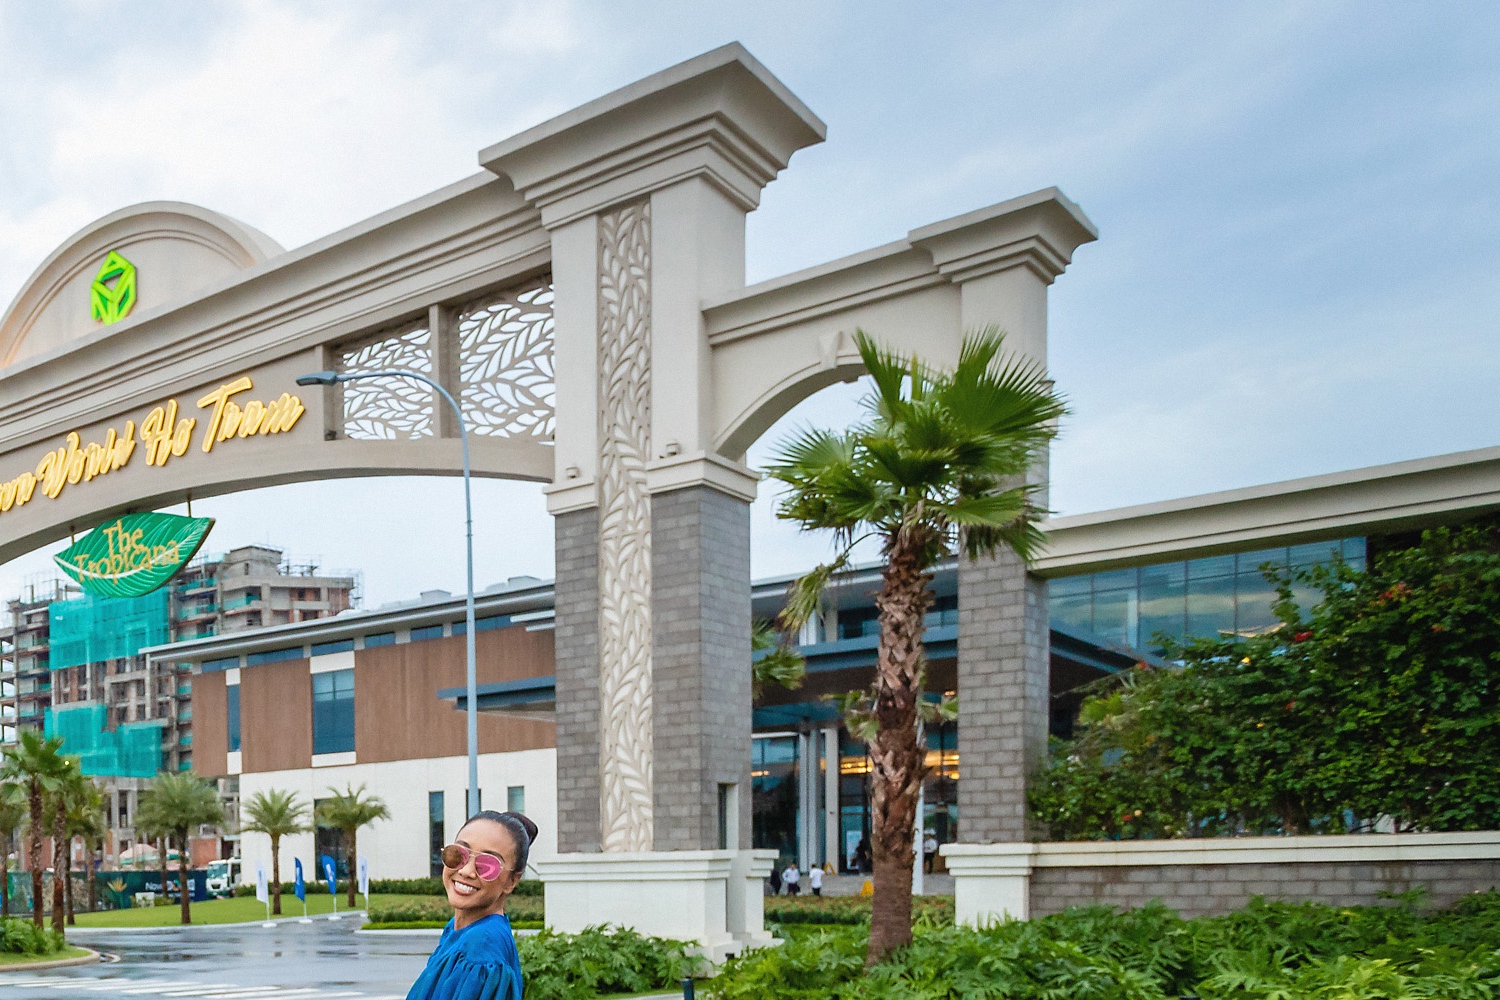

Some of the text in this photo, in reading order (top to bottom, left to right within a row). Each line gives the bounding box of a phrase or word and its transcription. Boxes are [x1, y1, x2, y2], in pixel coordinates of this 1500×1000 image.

[140, 399, 196, 466] Ho
[197, 376, 305, 452] Tram
[103, 519, 144, 556] The
[74, 540, 180, 585] Tropicana
